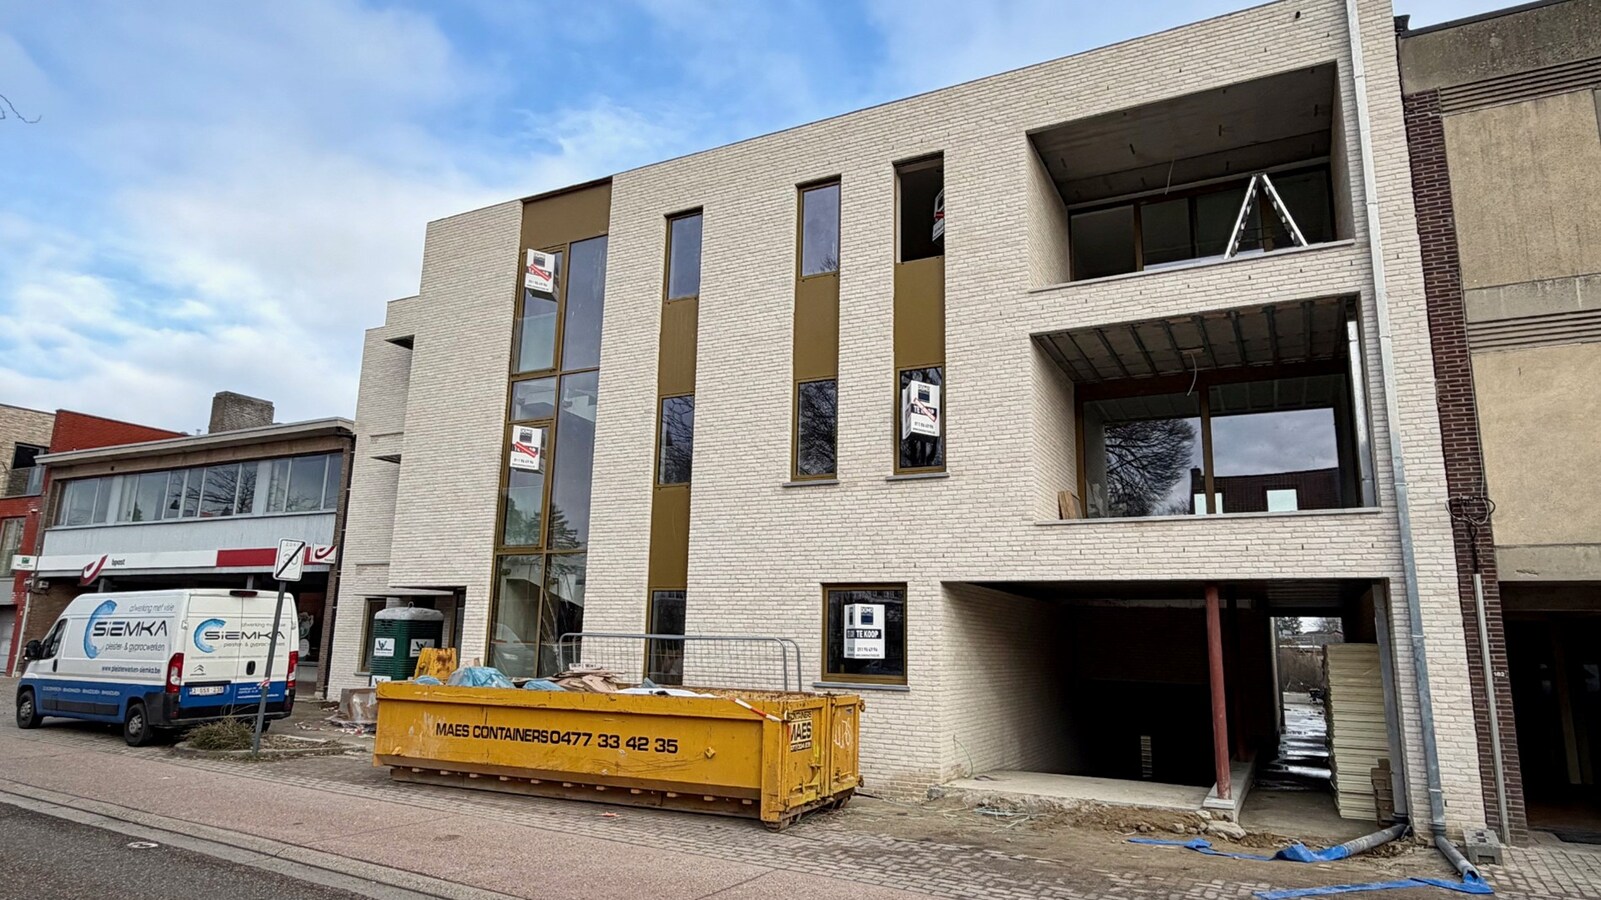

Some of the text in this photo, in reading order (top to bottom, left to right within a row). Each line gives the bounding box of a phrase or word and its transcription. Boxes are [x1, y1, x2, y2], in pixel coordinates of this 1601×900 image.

[111, 558, 125, 567] bpost
[856, 630, 864, 638] TE
[864, 630, 879, 638] KOOP
[124, 641, 128, 651] &
[435, 723, 679, 754] MAES CONTAINERS 0477 33 42 35
